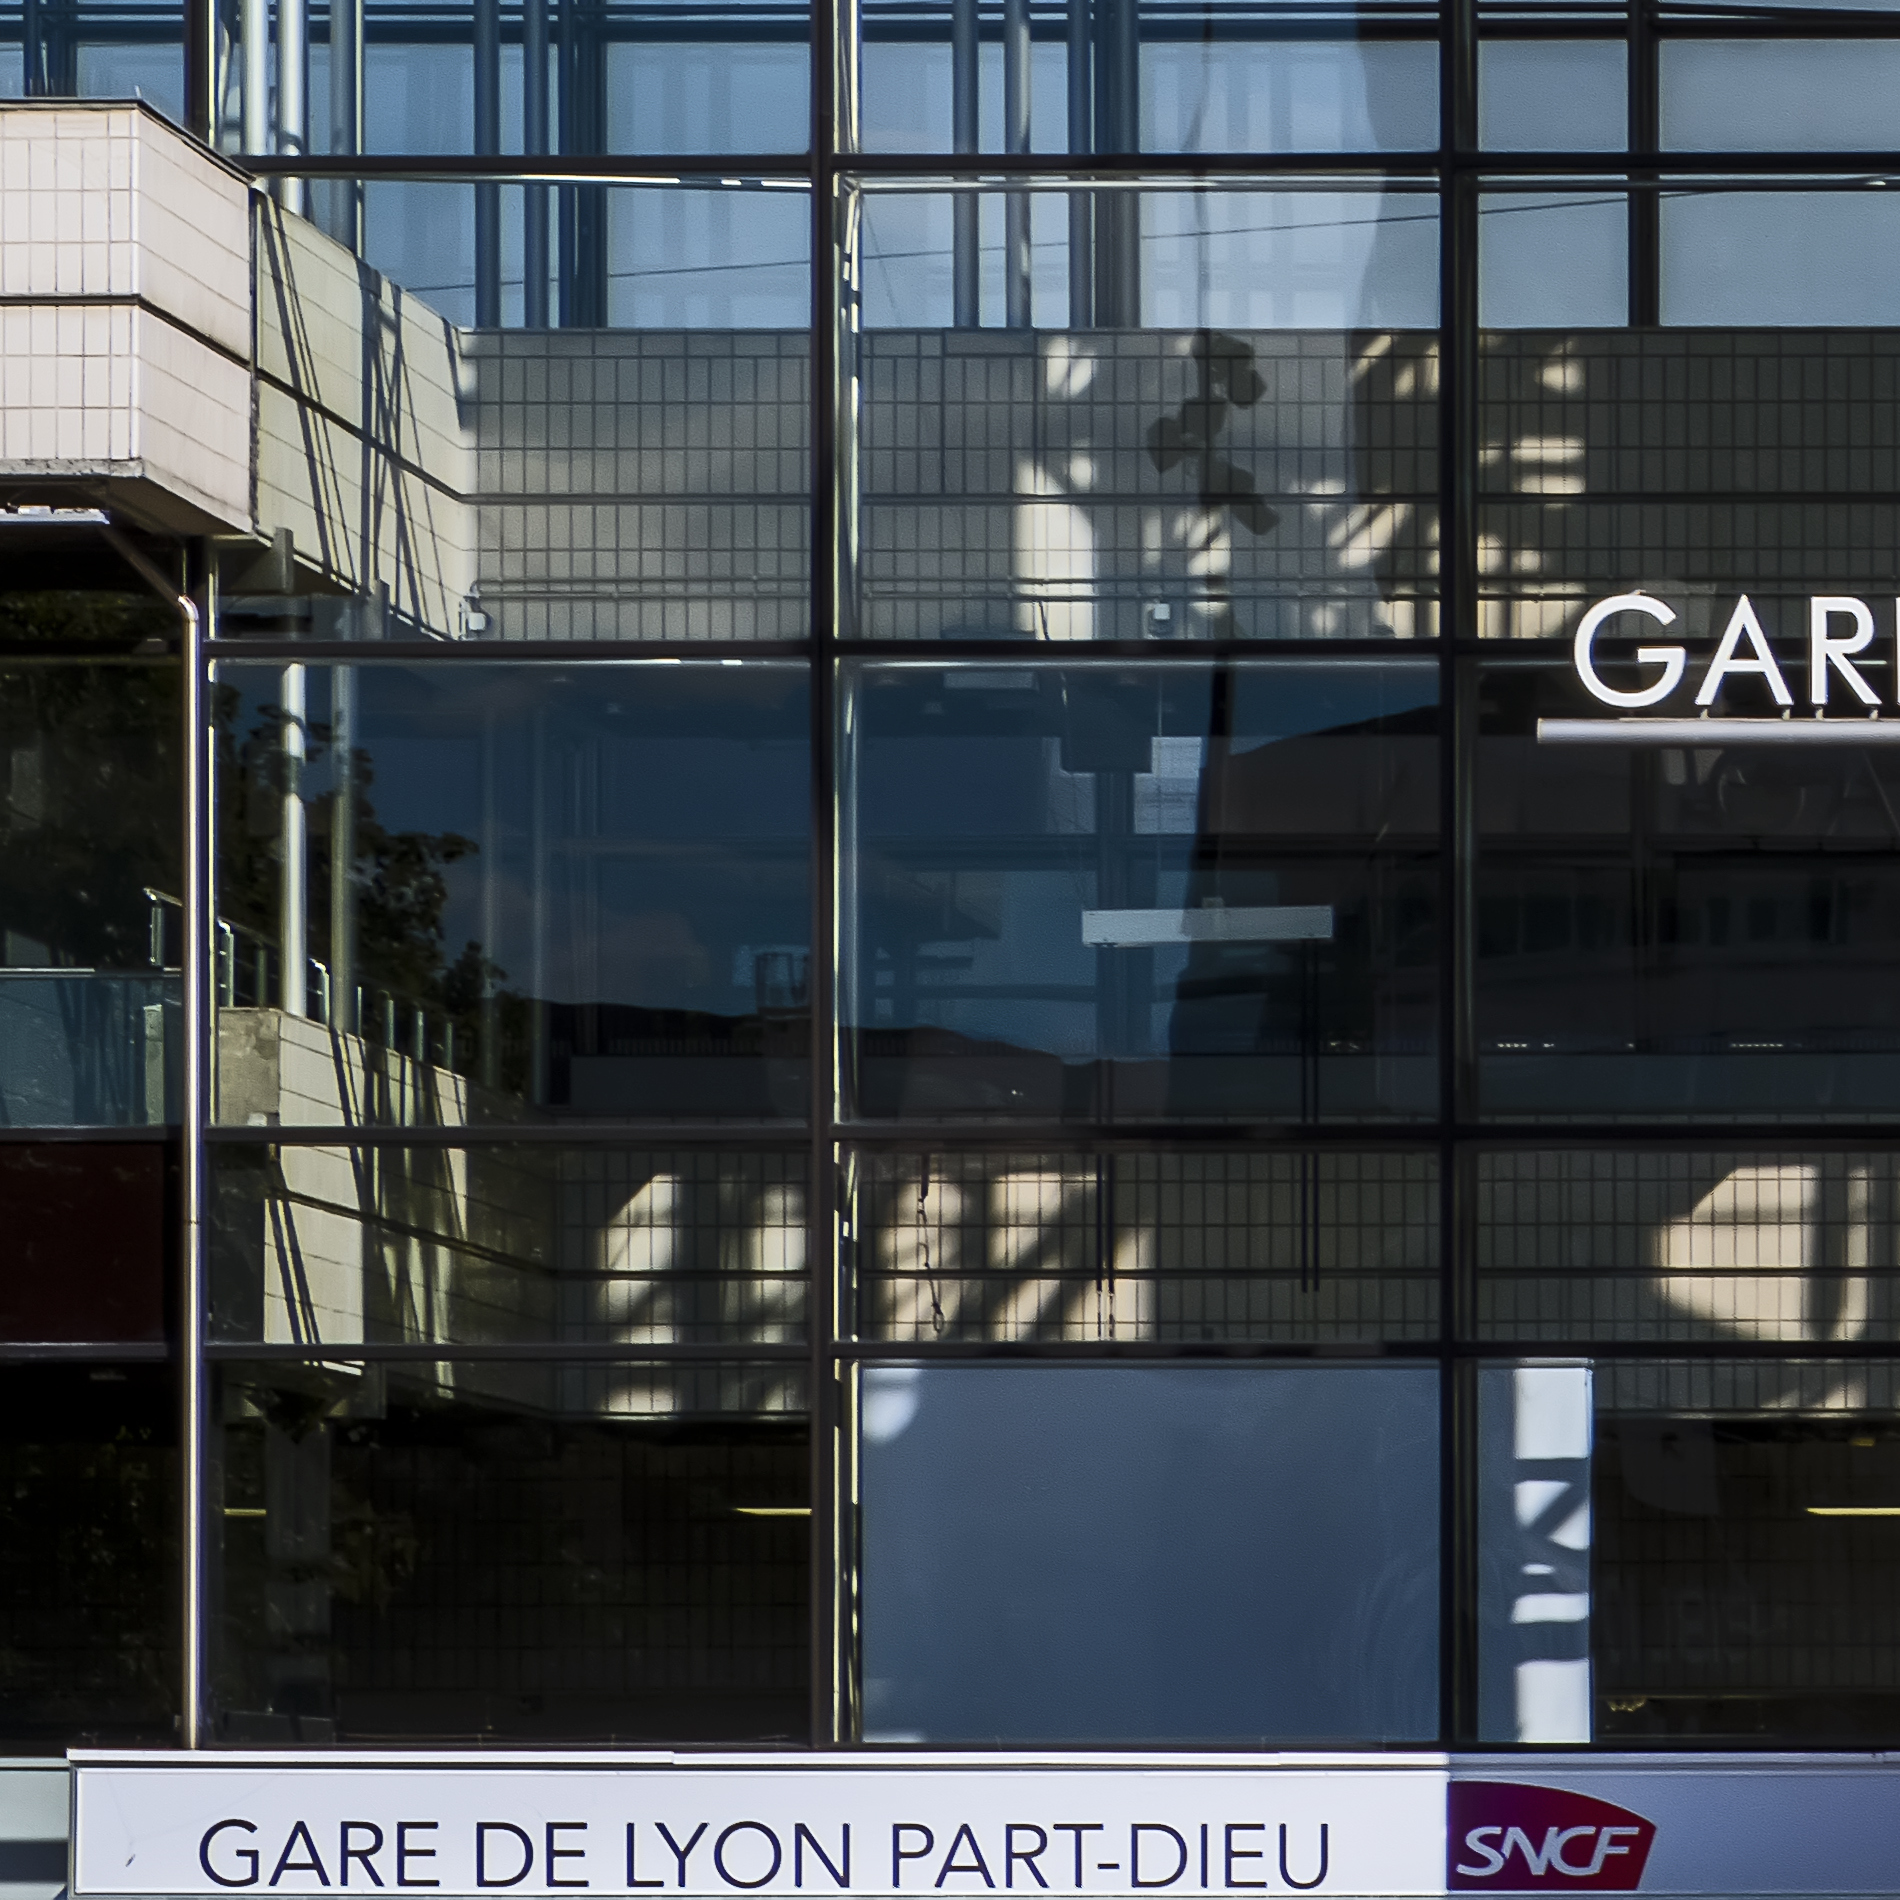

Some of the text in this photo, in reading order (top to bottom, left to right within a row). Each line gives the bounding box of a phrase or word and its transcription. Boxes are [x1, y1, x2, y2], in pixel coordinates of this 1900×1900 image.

[198, 1818, 1328, 1890] GARE DE LYON PART-DIEU
[1455, 1823, 1641, 1878] SNCF
